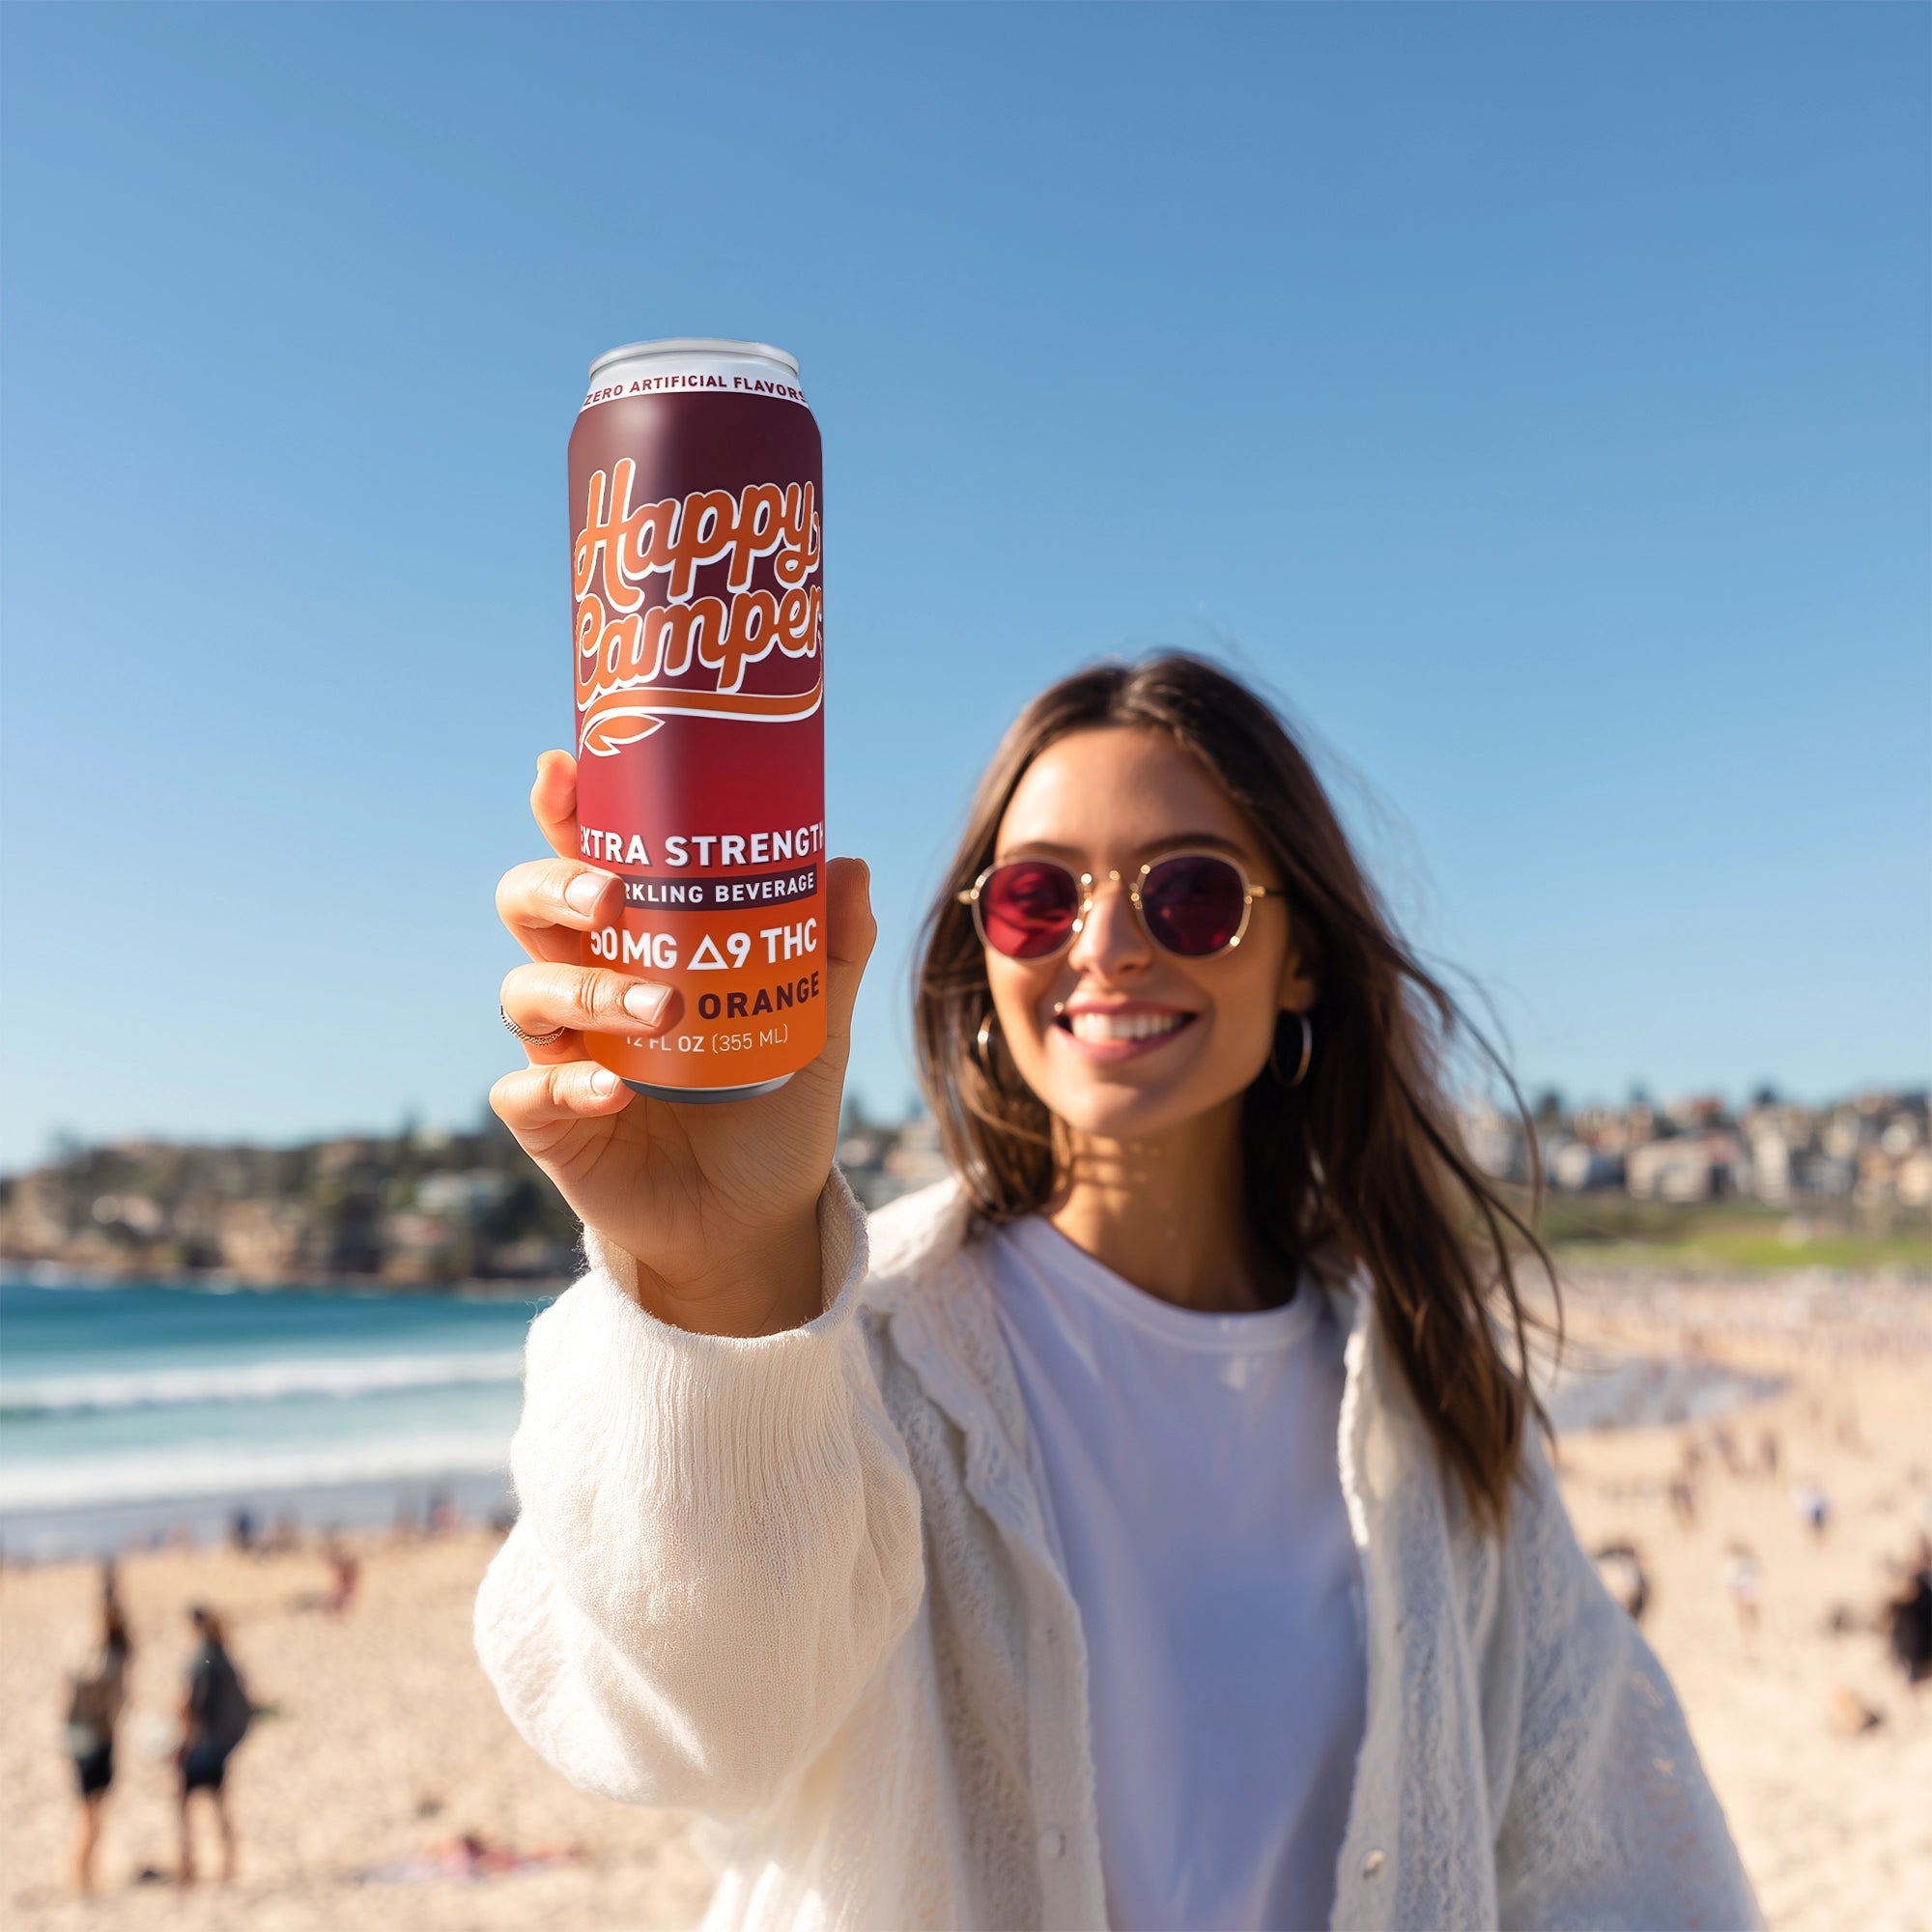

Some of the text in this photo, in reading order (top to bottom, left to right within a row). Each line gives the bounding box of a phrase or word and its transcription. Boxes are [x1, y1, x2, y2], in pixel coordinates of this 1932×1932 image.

[583, 384, 623, 406] ZERO
[630, 375, 727, 393] ARTIFICIAL
[575, 457, 820, 613] Happy
[576, 585, 822, 712] Camper
[581, 824, 651, 866] XTRA
[715, 871, 815, 903] BEVERAGE
[759, 918, 817, 964] THC
[697, 970, 820, 1020] ORANGE
[677, 1035, 705, 1053] OZ
[712, 1034, 753, 1055] (355
[759, 1023, 788, 1048] ML)
